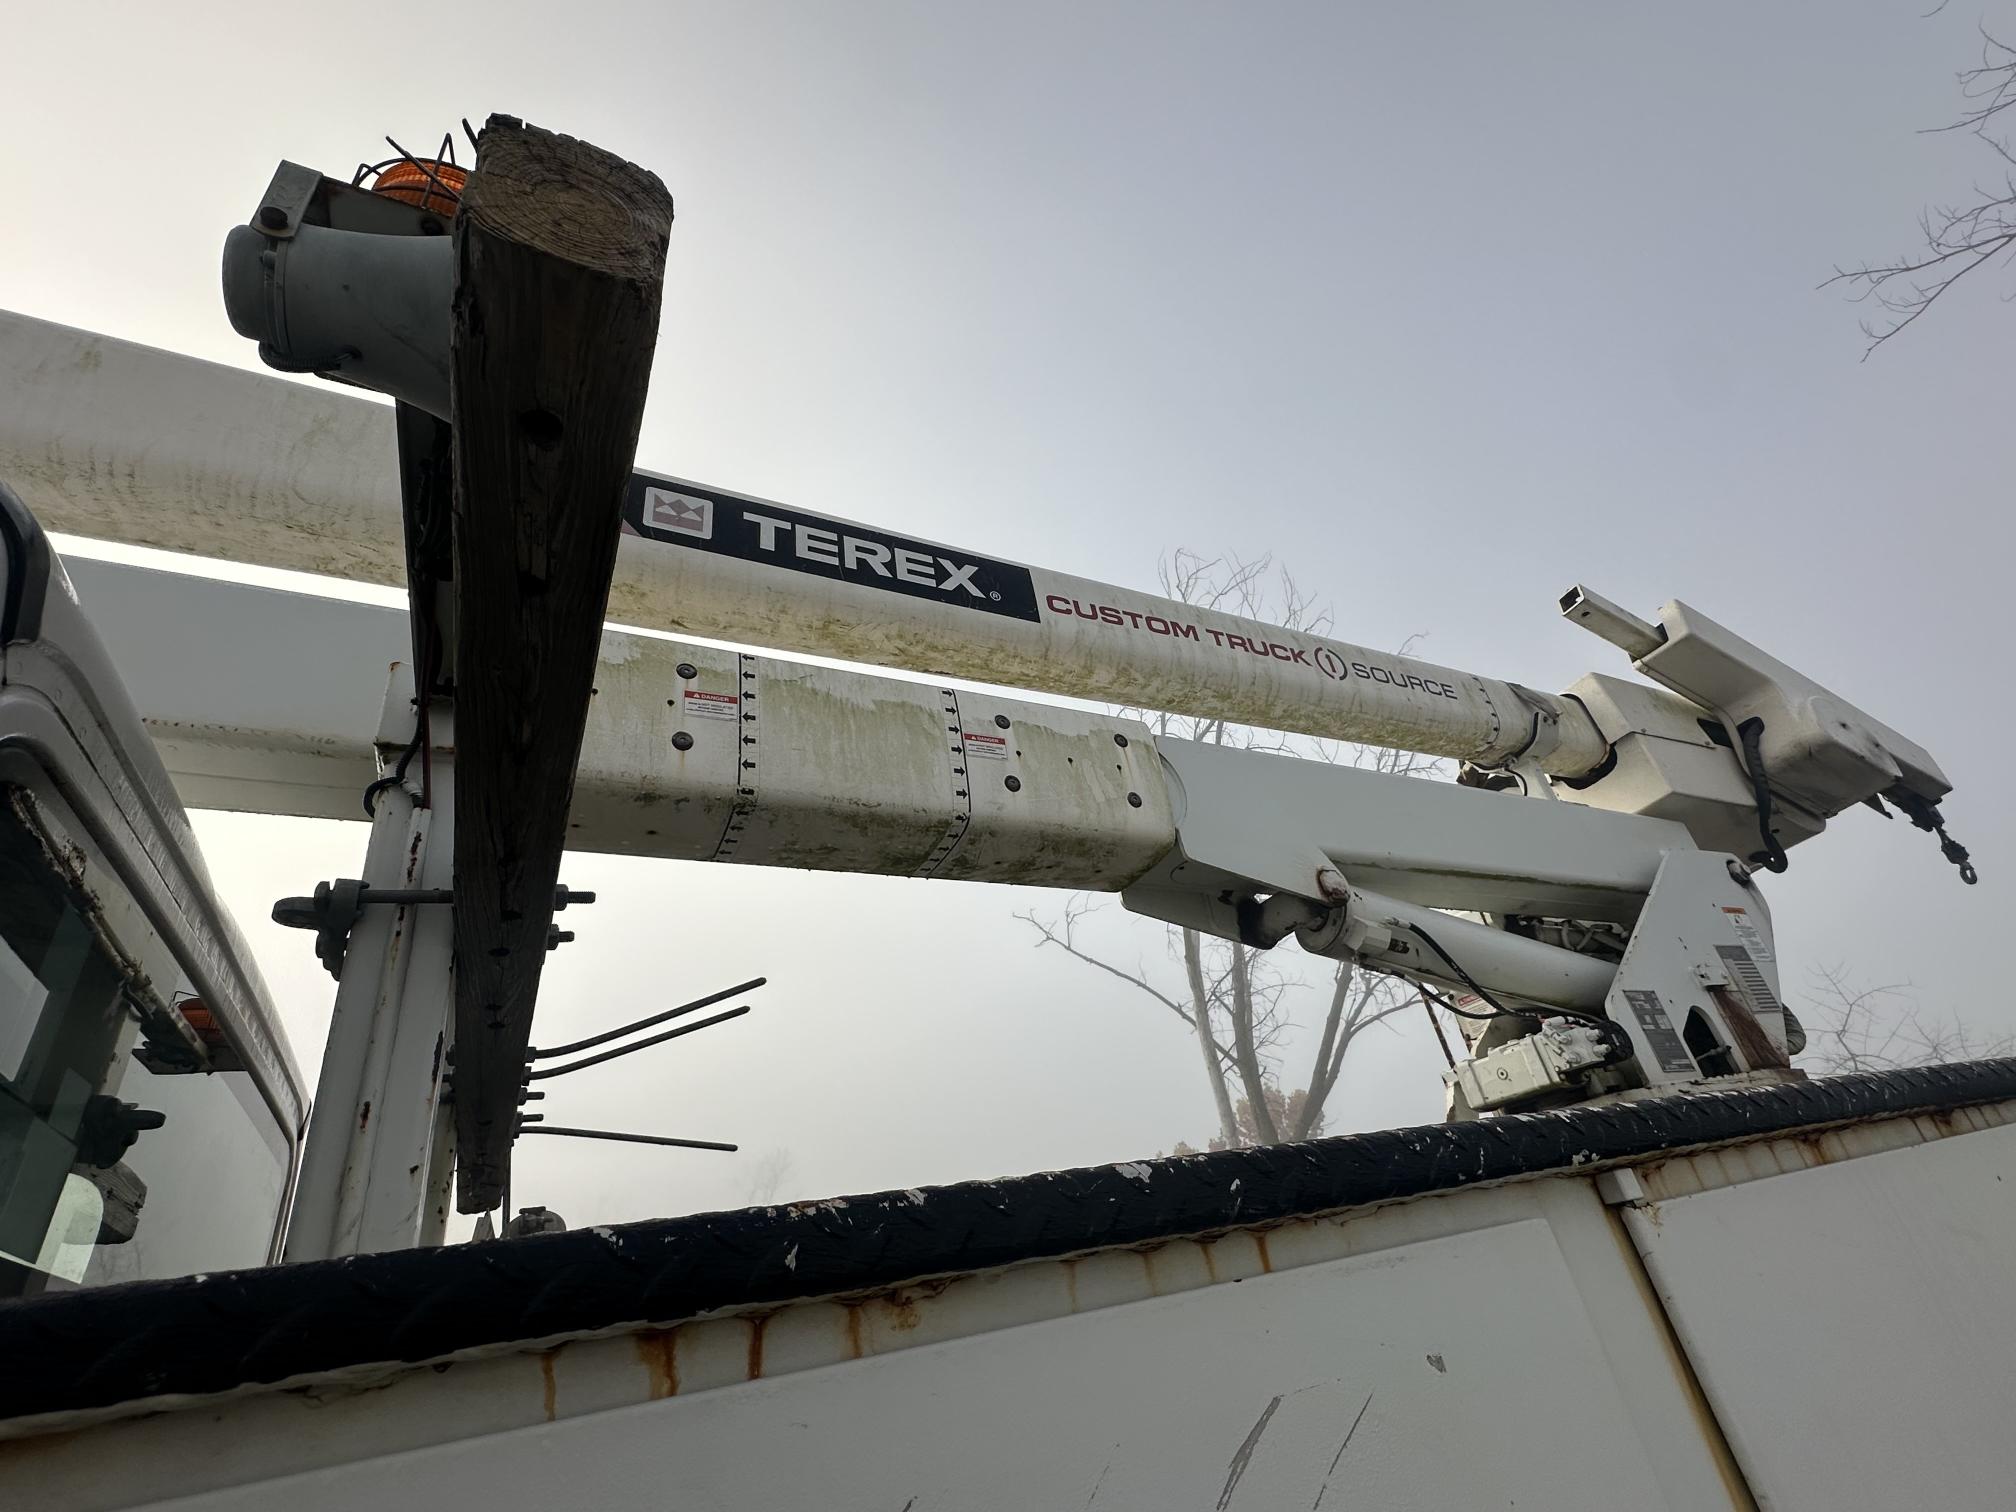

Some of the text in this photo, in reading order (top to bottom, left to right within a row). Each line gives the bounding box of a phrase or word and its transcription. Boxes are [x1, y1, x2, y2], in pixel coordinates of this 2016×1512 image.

[743, 512, 986, 599] TEREX
[1046, 595, 1200, 641] CUSTOM
[1206, 629, 1313, 667] TRUCK
[1352, 662, 1458, 700] SOURCE
[701, 694, 730, 702] DANGER
[976, 735, 1000, 744] DANGER
